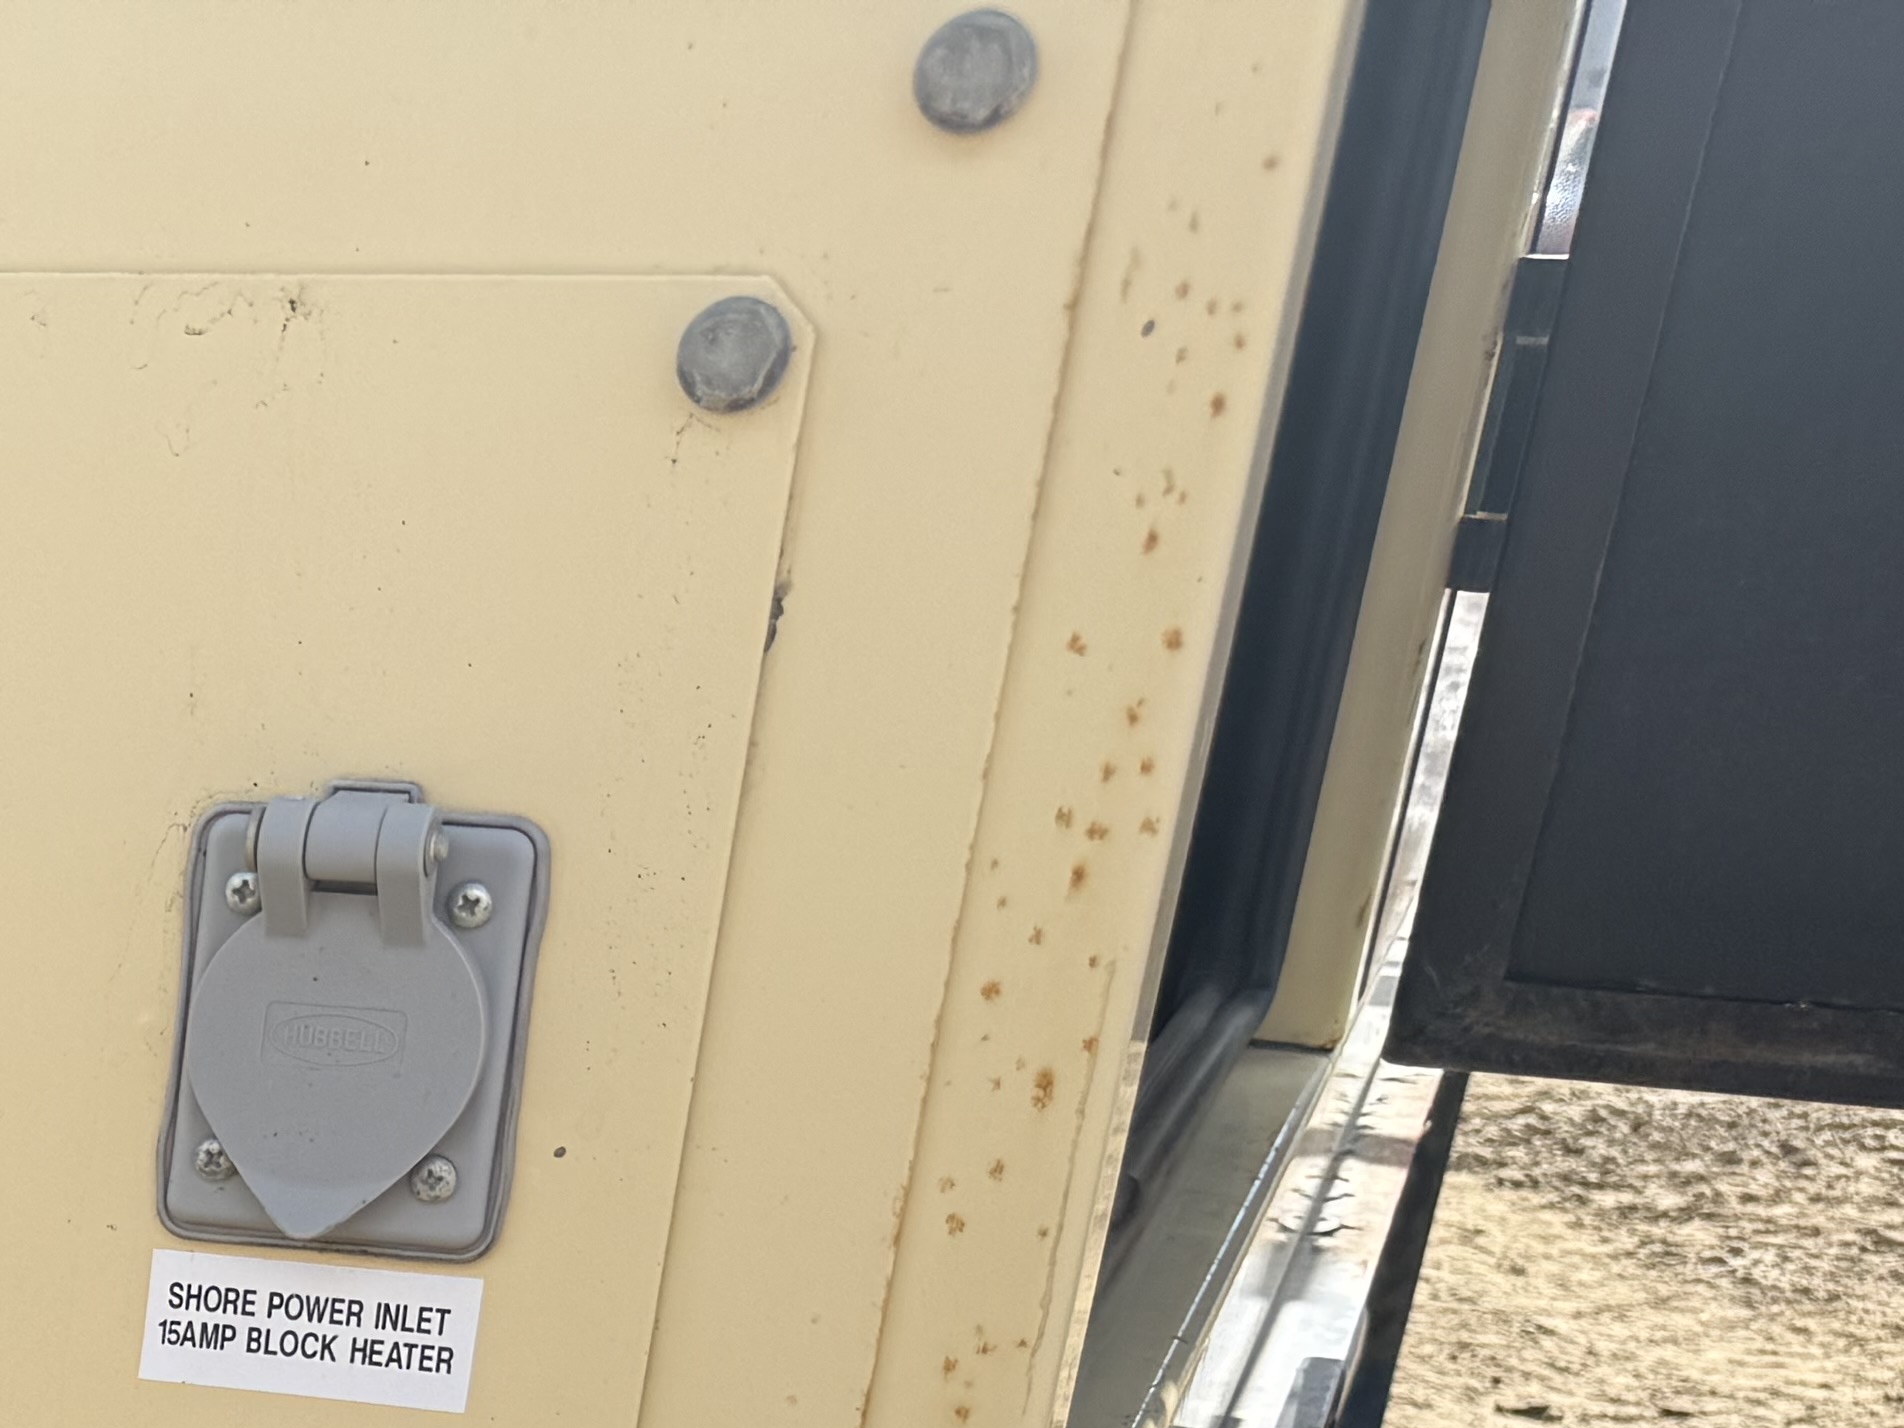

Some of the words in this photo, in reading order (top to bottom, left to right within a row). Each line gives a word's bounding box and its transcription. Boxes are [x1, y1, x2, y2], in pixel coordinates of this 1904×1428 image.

[282, 1022, 387, 1054] HUBBELL
[168, 1281, 257, 1317] SHORE
[266, 1291, 364, 1328] POWER
[374, 1302, 452, 1336] INLET
[158, 1319, 237, 1351] 15AMP
[246, 1326, 339, 1363] BLOCK
[349, 1337, 454, 1375] HEATER
